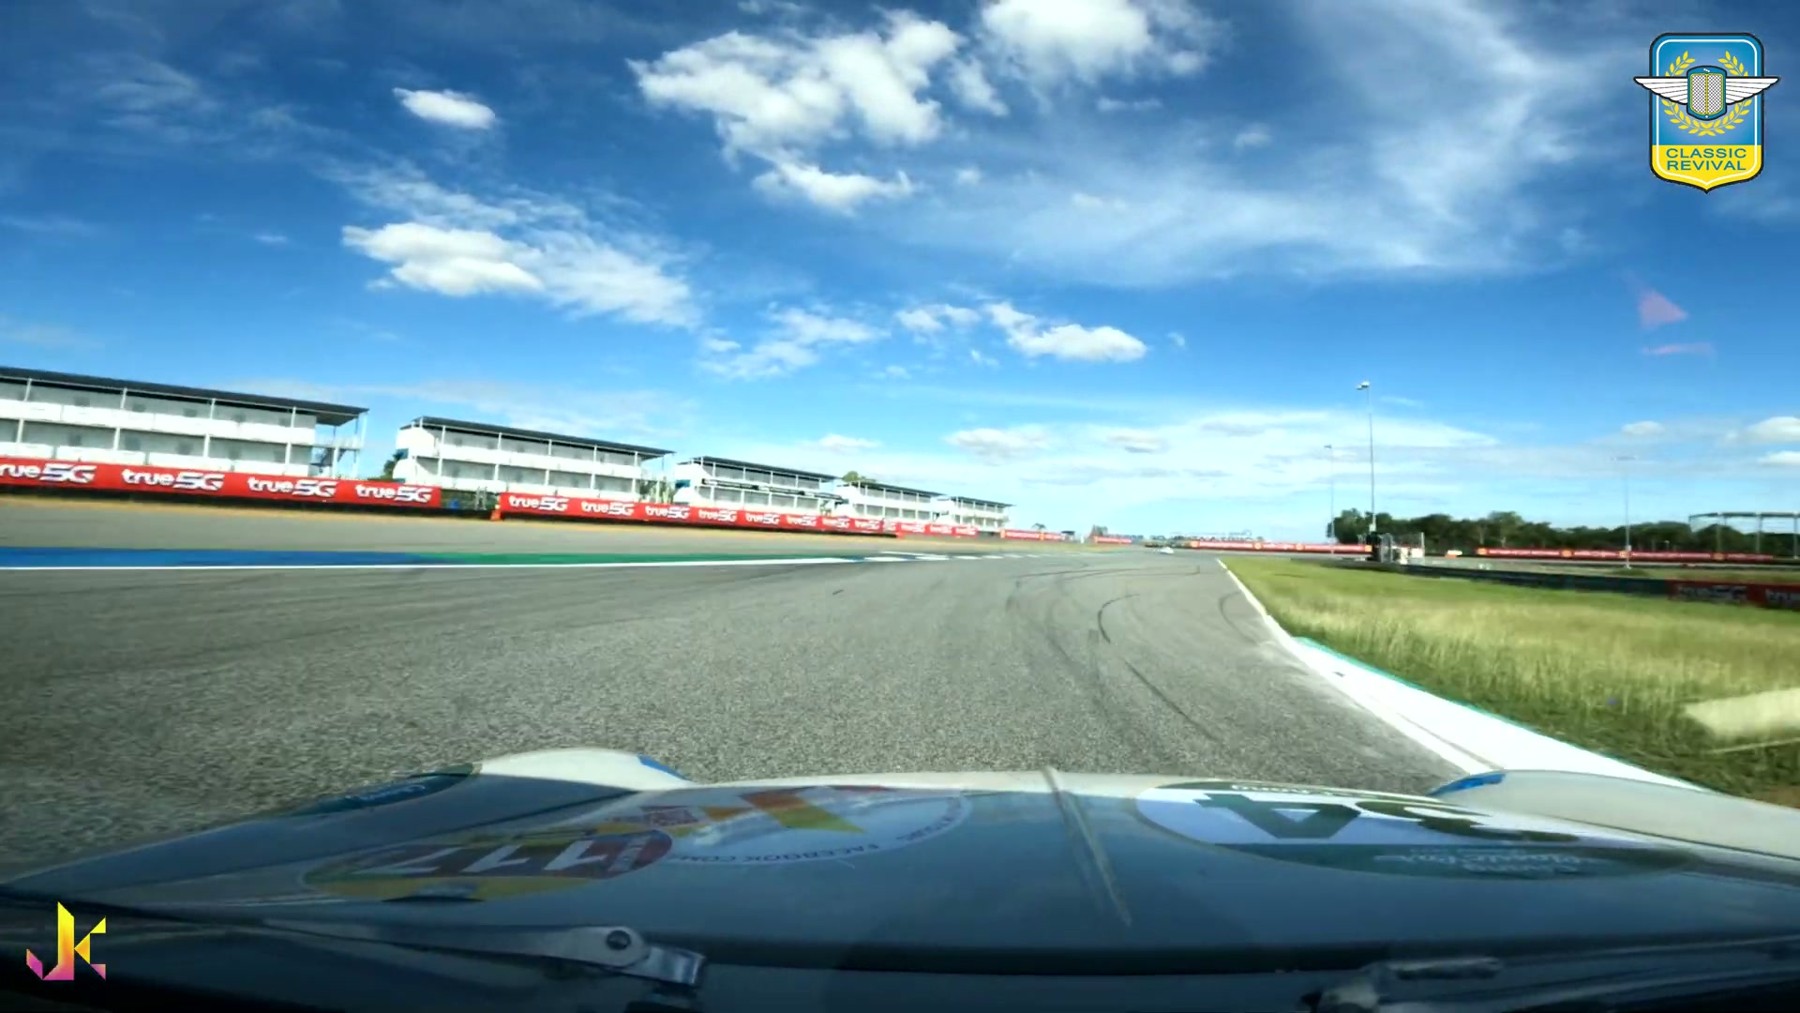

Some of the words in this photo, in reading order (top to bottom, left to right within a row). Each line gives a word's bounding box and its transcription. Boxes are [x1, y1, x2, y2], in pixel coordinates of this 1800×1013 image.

[0, 462, 97, 484] rue5G
[121, 468, 225, 491] true5G
[247, 477, 339, 497] true5G
[355, 484, 432, 503] true5G
[509, 495, 569, 511] true5G
